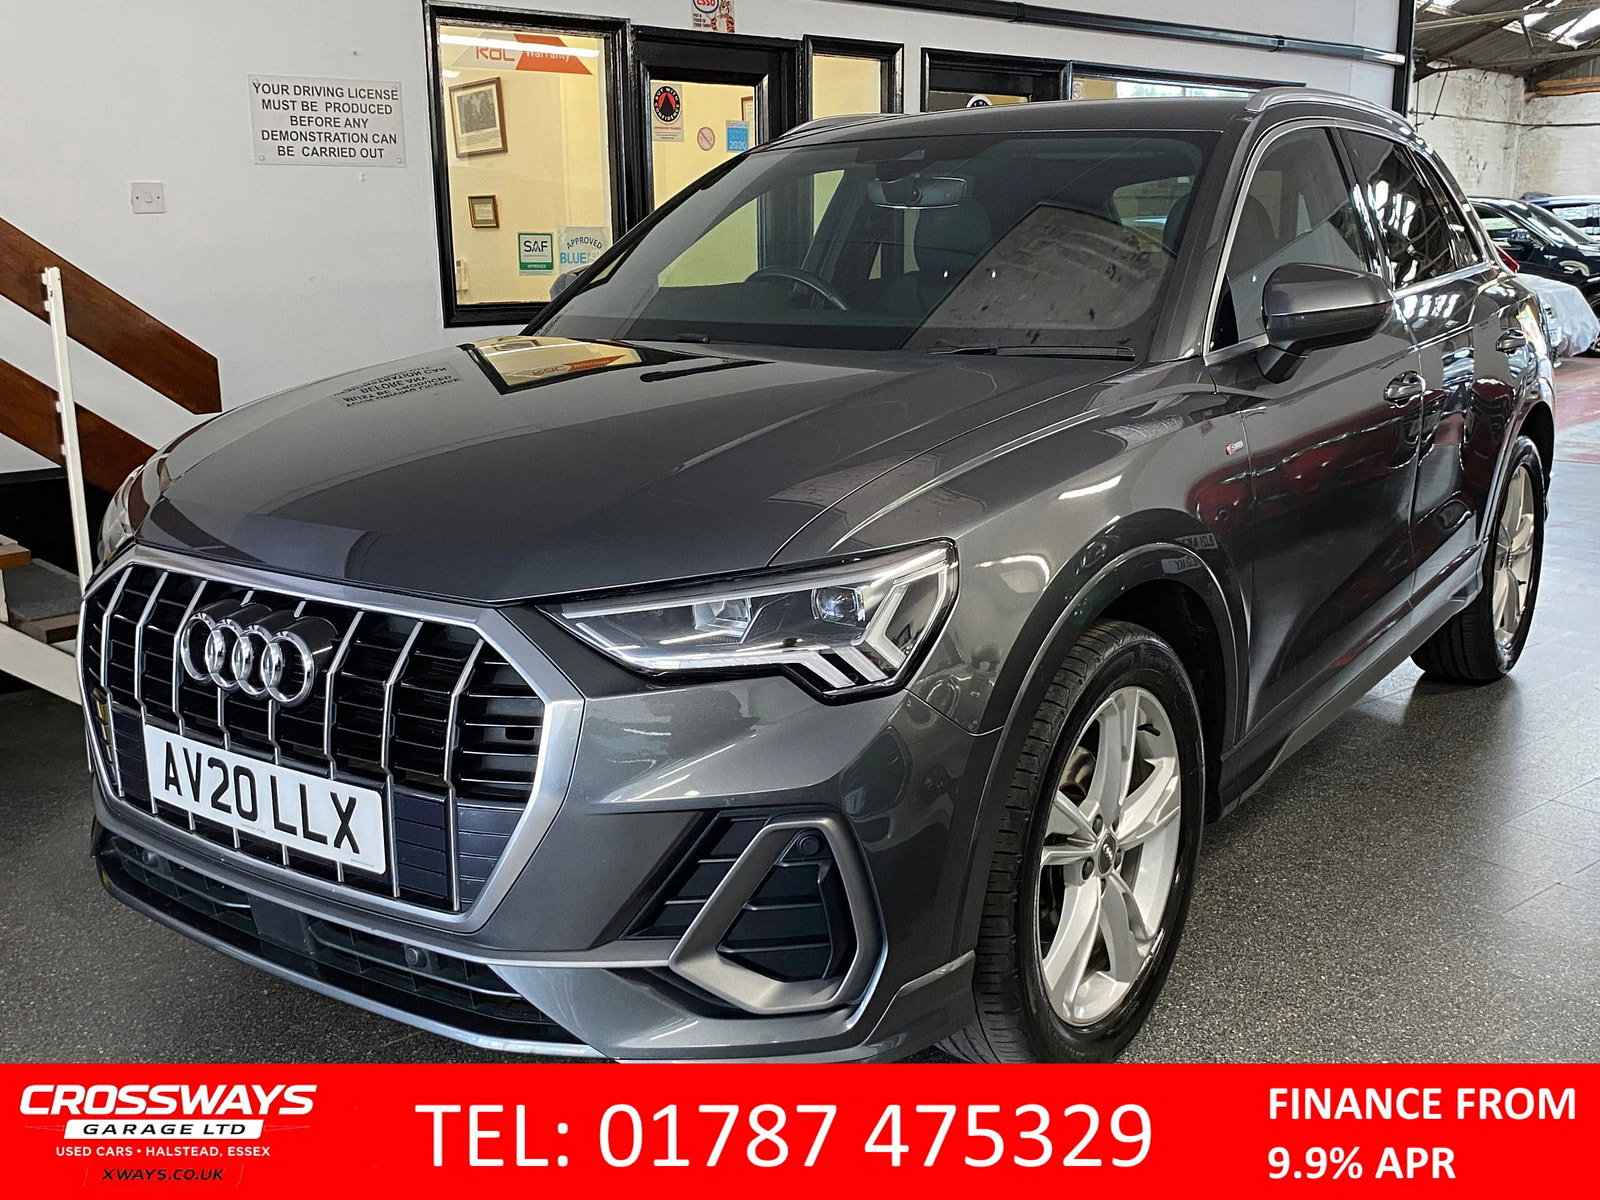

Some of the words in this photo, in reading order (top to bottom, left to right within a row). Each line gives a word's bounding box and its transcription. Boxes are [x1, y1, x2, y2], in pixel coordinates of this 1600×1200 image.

[252, 82, 290, 95] YOUR
[294, 85, 344, 98] DRIVING
[348, 88, 398, 100] LICENSE
[262, 99, 296, 110] MUST
[302, 102, 318, 112] BE
[325, 102, 392, 114] PRODUCED
[290, 116, 341, 128] BEFORE
[344, 118, 368, 128] ANY
[262, 130, 368, 143] DEMONSTRATION
[372, 134, 397, 144] CAN
[729, 140, 747, 150] 2020
[278, 146, 294, 156] BE
[302, 147, 356, 158] CARRIED
[360, 148, 384, 158] OUT
[524, 240, 548, 252] SAF
[567, 237, 602, 249] APPROVED
[560, 252, 586, 263] BLUE
[164, 742, 258, 822] AV20
[270, 775, 360, 854] LLX
